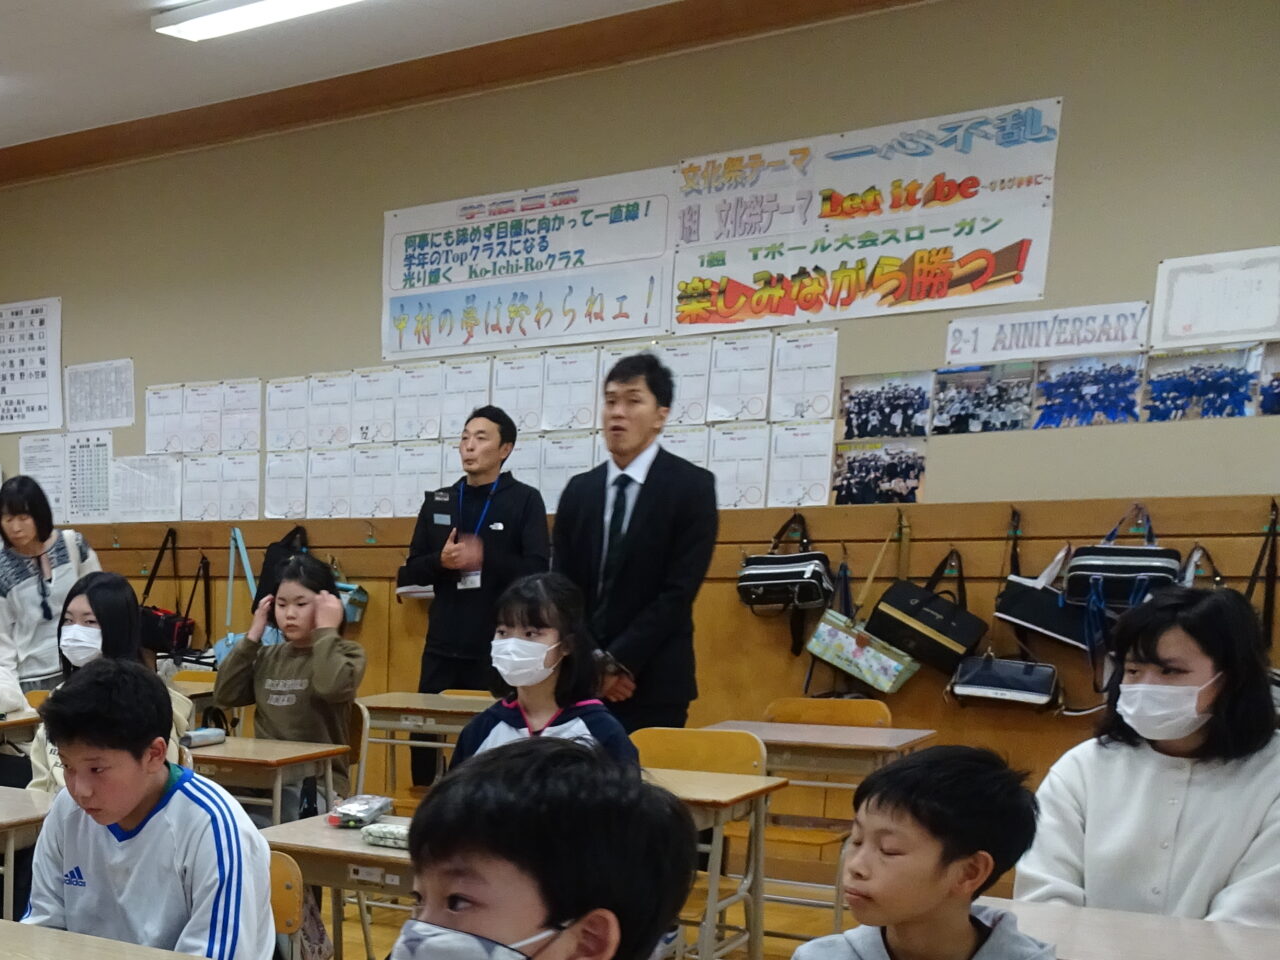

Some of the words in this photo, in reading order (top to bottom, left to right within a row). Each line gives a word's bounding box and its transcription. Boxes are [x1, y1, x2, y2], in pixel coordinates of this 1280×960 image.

[825, 106, 1057, 160] 一心不乱
[679, 146, 812, 196] 文化祭テーマ
[818, 186, 883, 220] Let
[890, 179, 924, 209] it
[927, 172, 981, 206] be
[714, 190, 813, 241] 文化祭テーマ
[951, 329, 980, 353] 2-1
[992, 307, 1148, 351] ANNIVERSARY
